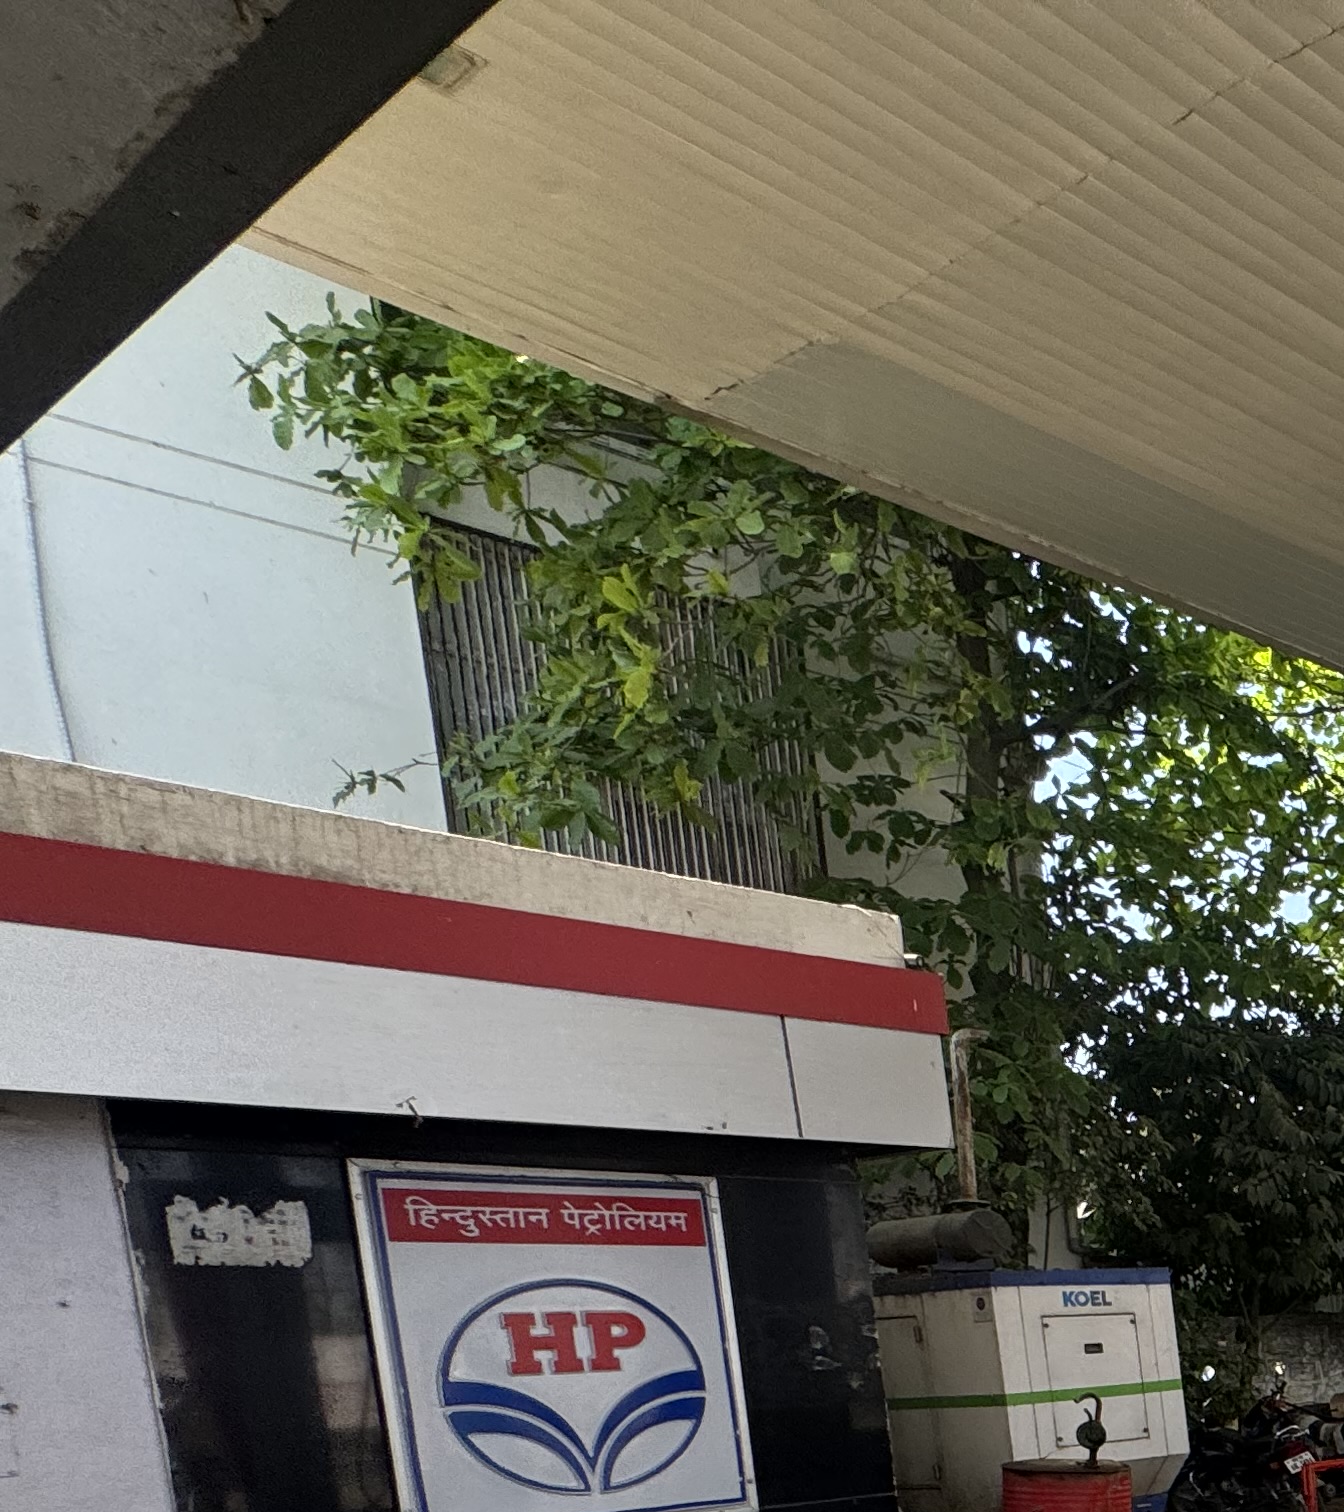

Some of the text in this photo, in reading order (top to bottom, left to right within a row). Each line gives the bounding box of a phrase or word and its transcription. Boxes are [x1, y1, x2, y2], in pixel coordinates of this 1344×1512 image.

[404, 1196, 688, 1237] हिन्दुस्तान पेट्रोलियम
[1062, 1290, 1113, 1307] KOEL
[501, 1311, 646, 1376] HP
